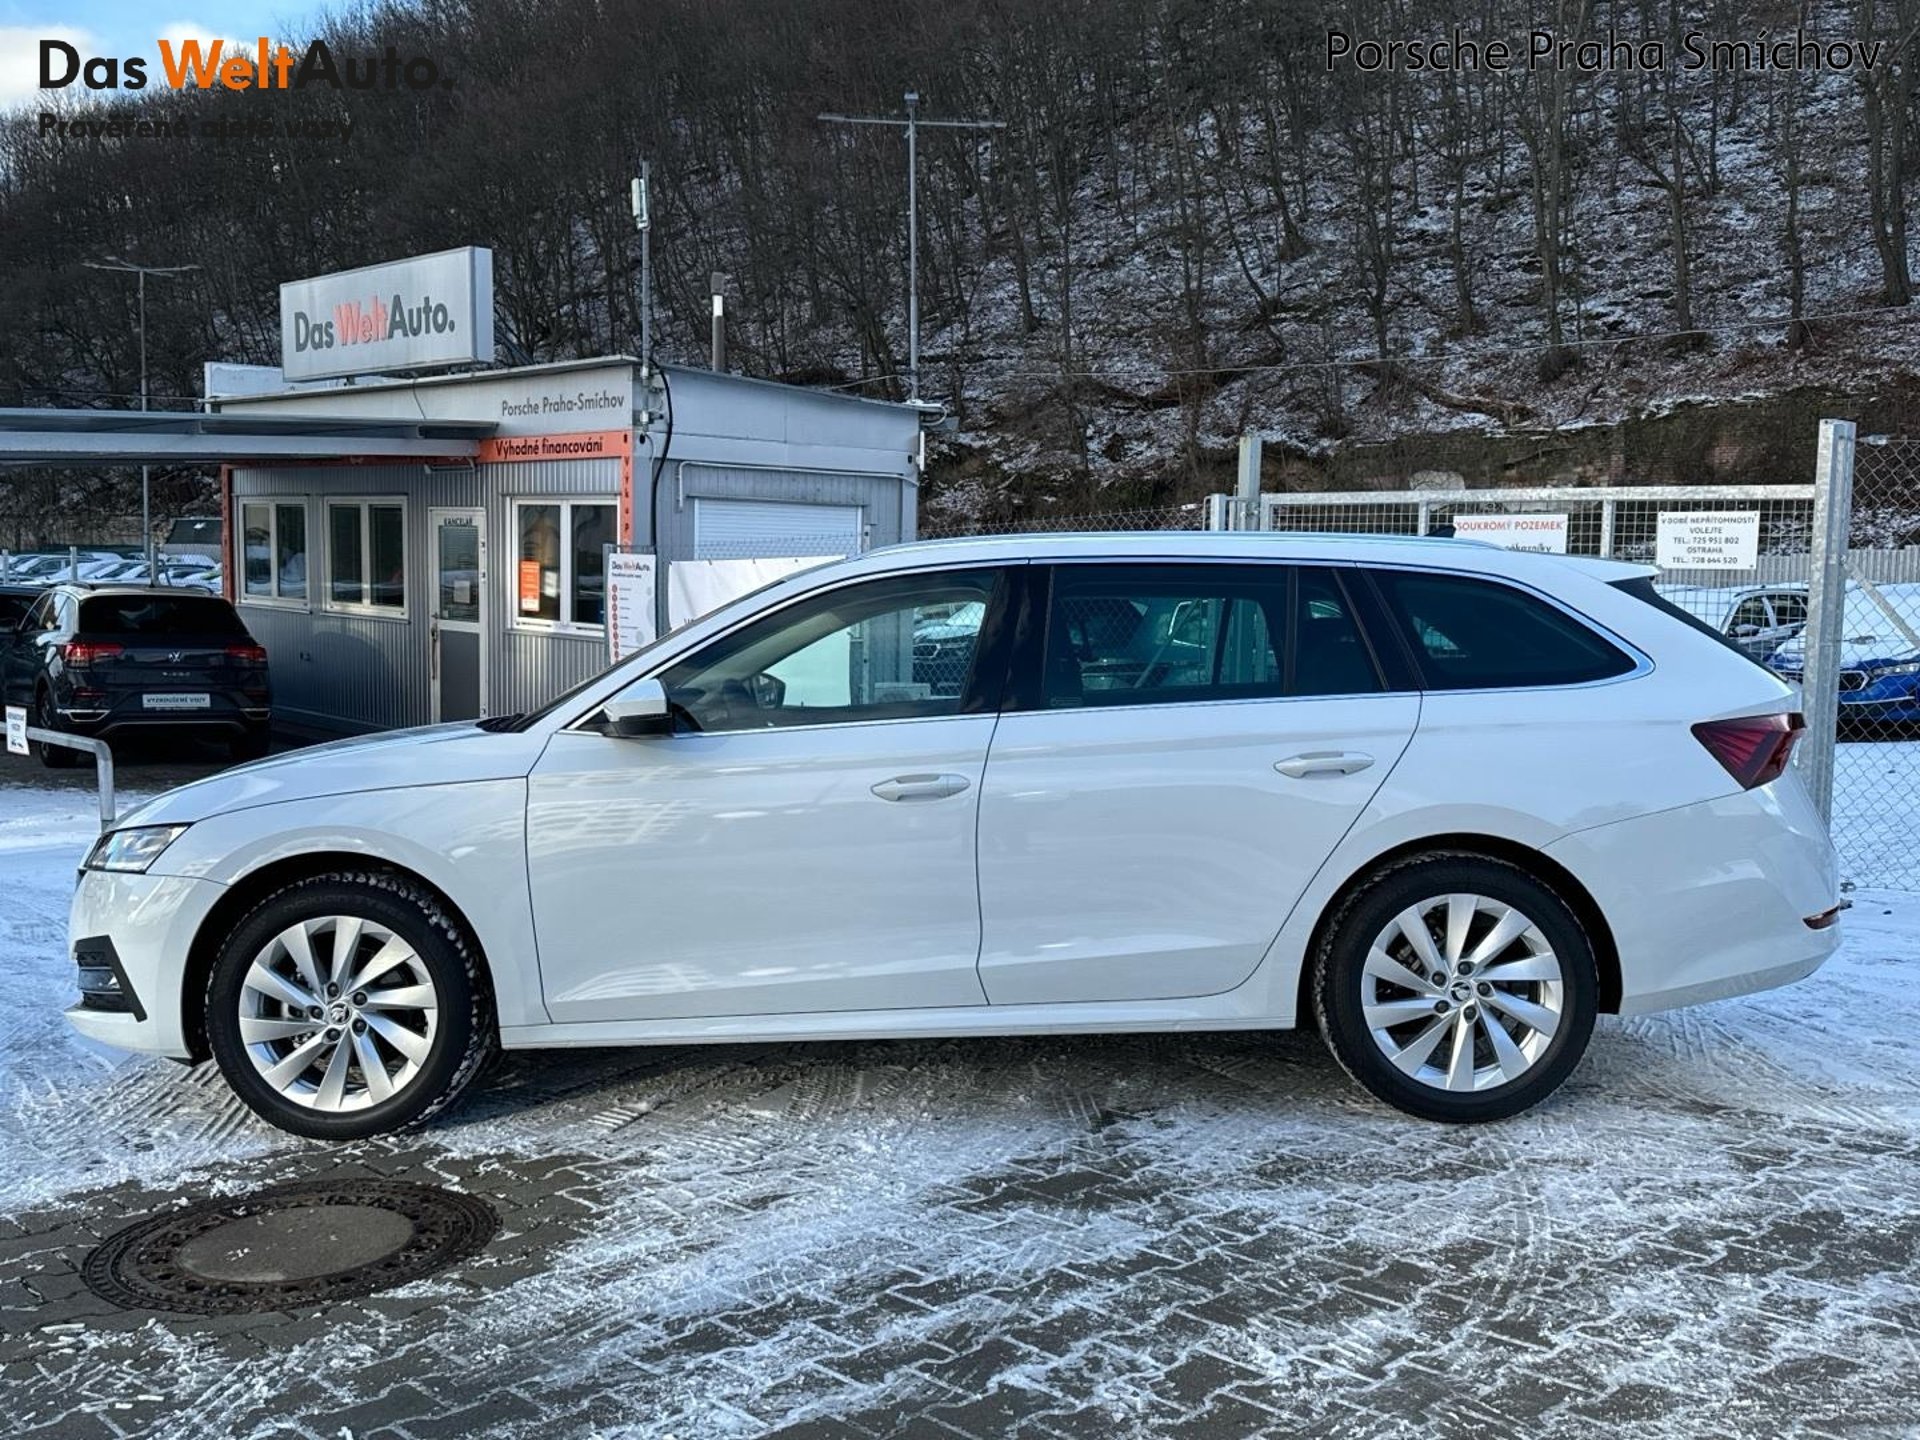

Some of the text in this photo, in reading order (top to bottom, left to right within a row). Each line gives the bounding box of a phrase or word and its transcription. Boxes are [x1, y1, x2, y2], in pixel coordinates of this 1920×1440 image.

[294, 309, 334, 352] Das
[501, 389, 625, 417] Porsche Praha-Smíchov
[495, 436, 604, 459] Výhodné financování
[1514, 520, 1564, 531] POZEMEK
[1689, 526, 1723, 534] VOLEJTE
